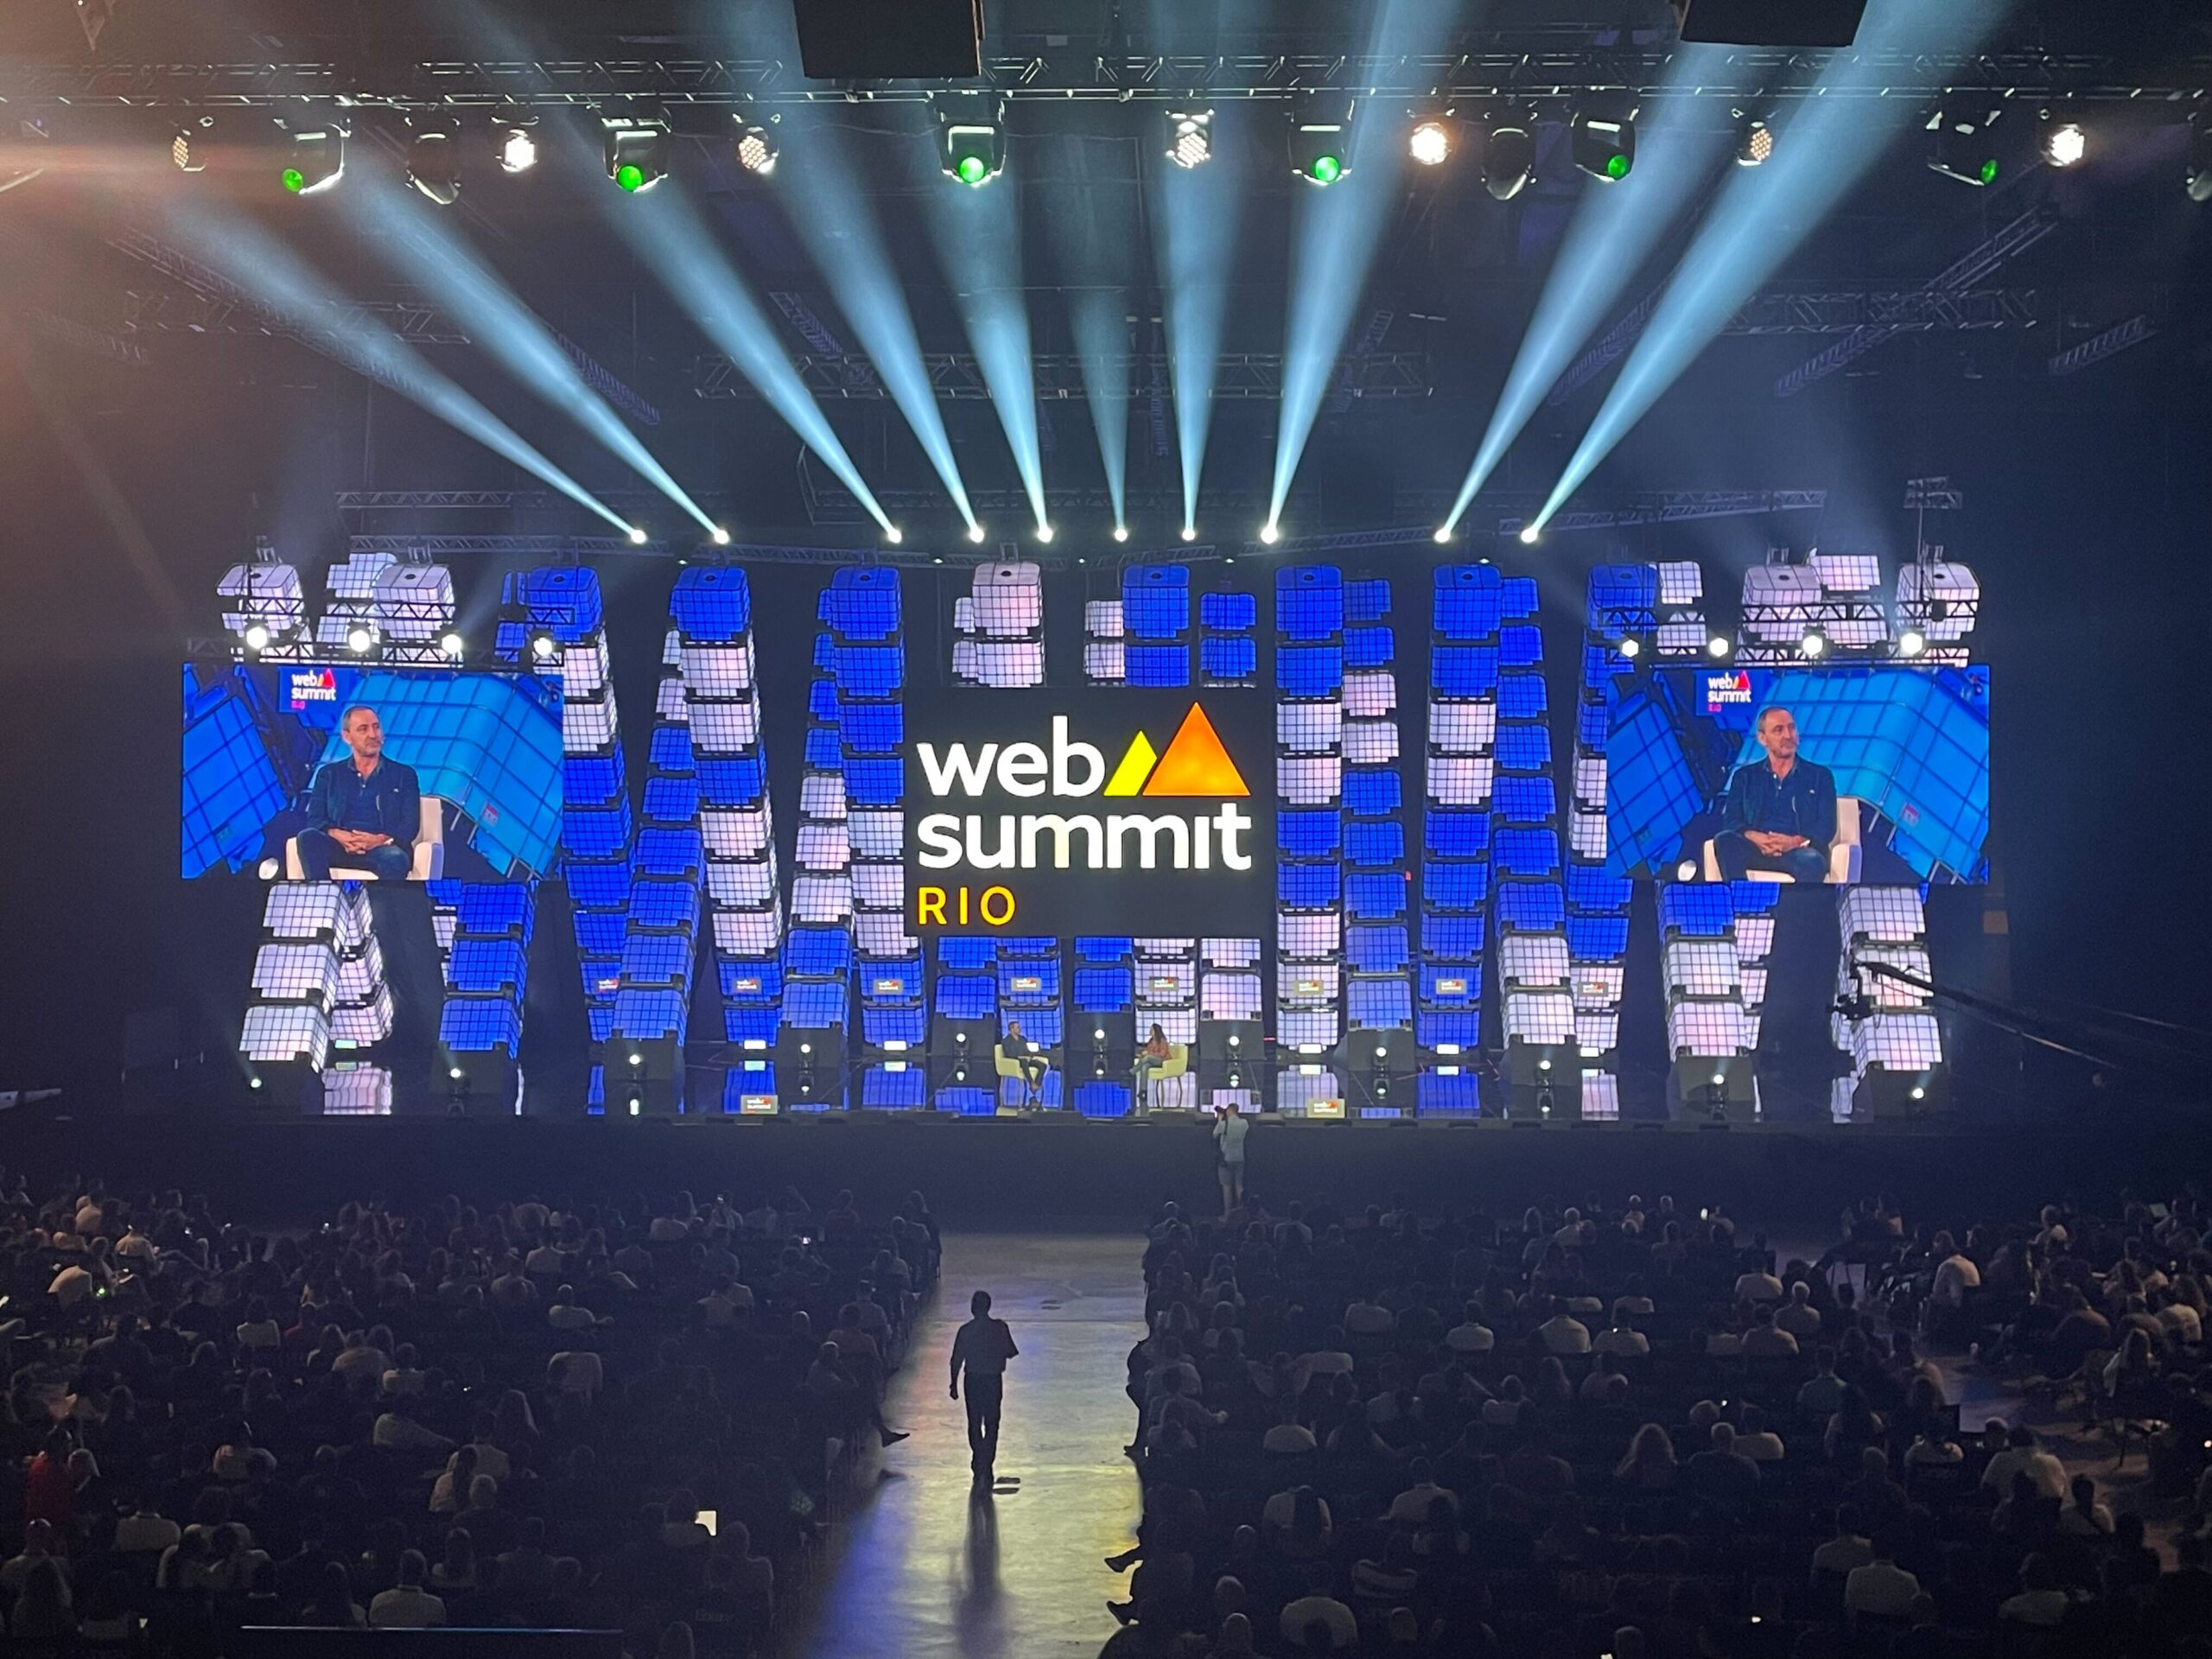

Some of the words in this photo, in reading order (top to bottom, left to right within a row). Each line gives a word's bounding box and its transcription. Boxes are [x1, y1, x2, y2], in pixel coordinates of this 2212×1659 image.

[291, 669, 317, 687] web
[1707, 671, 1732, 690] web
[291, 687, 337, 702] summit
[1707, 689, 1751, 703] summit
[916, 715, 1105, 797] web
[917, 802, 1252, 871] summit
[917, 885, 1017, 926] RIO
